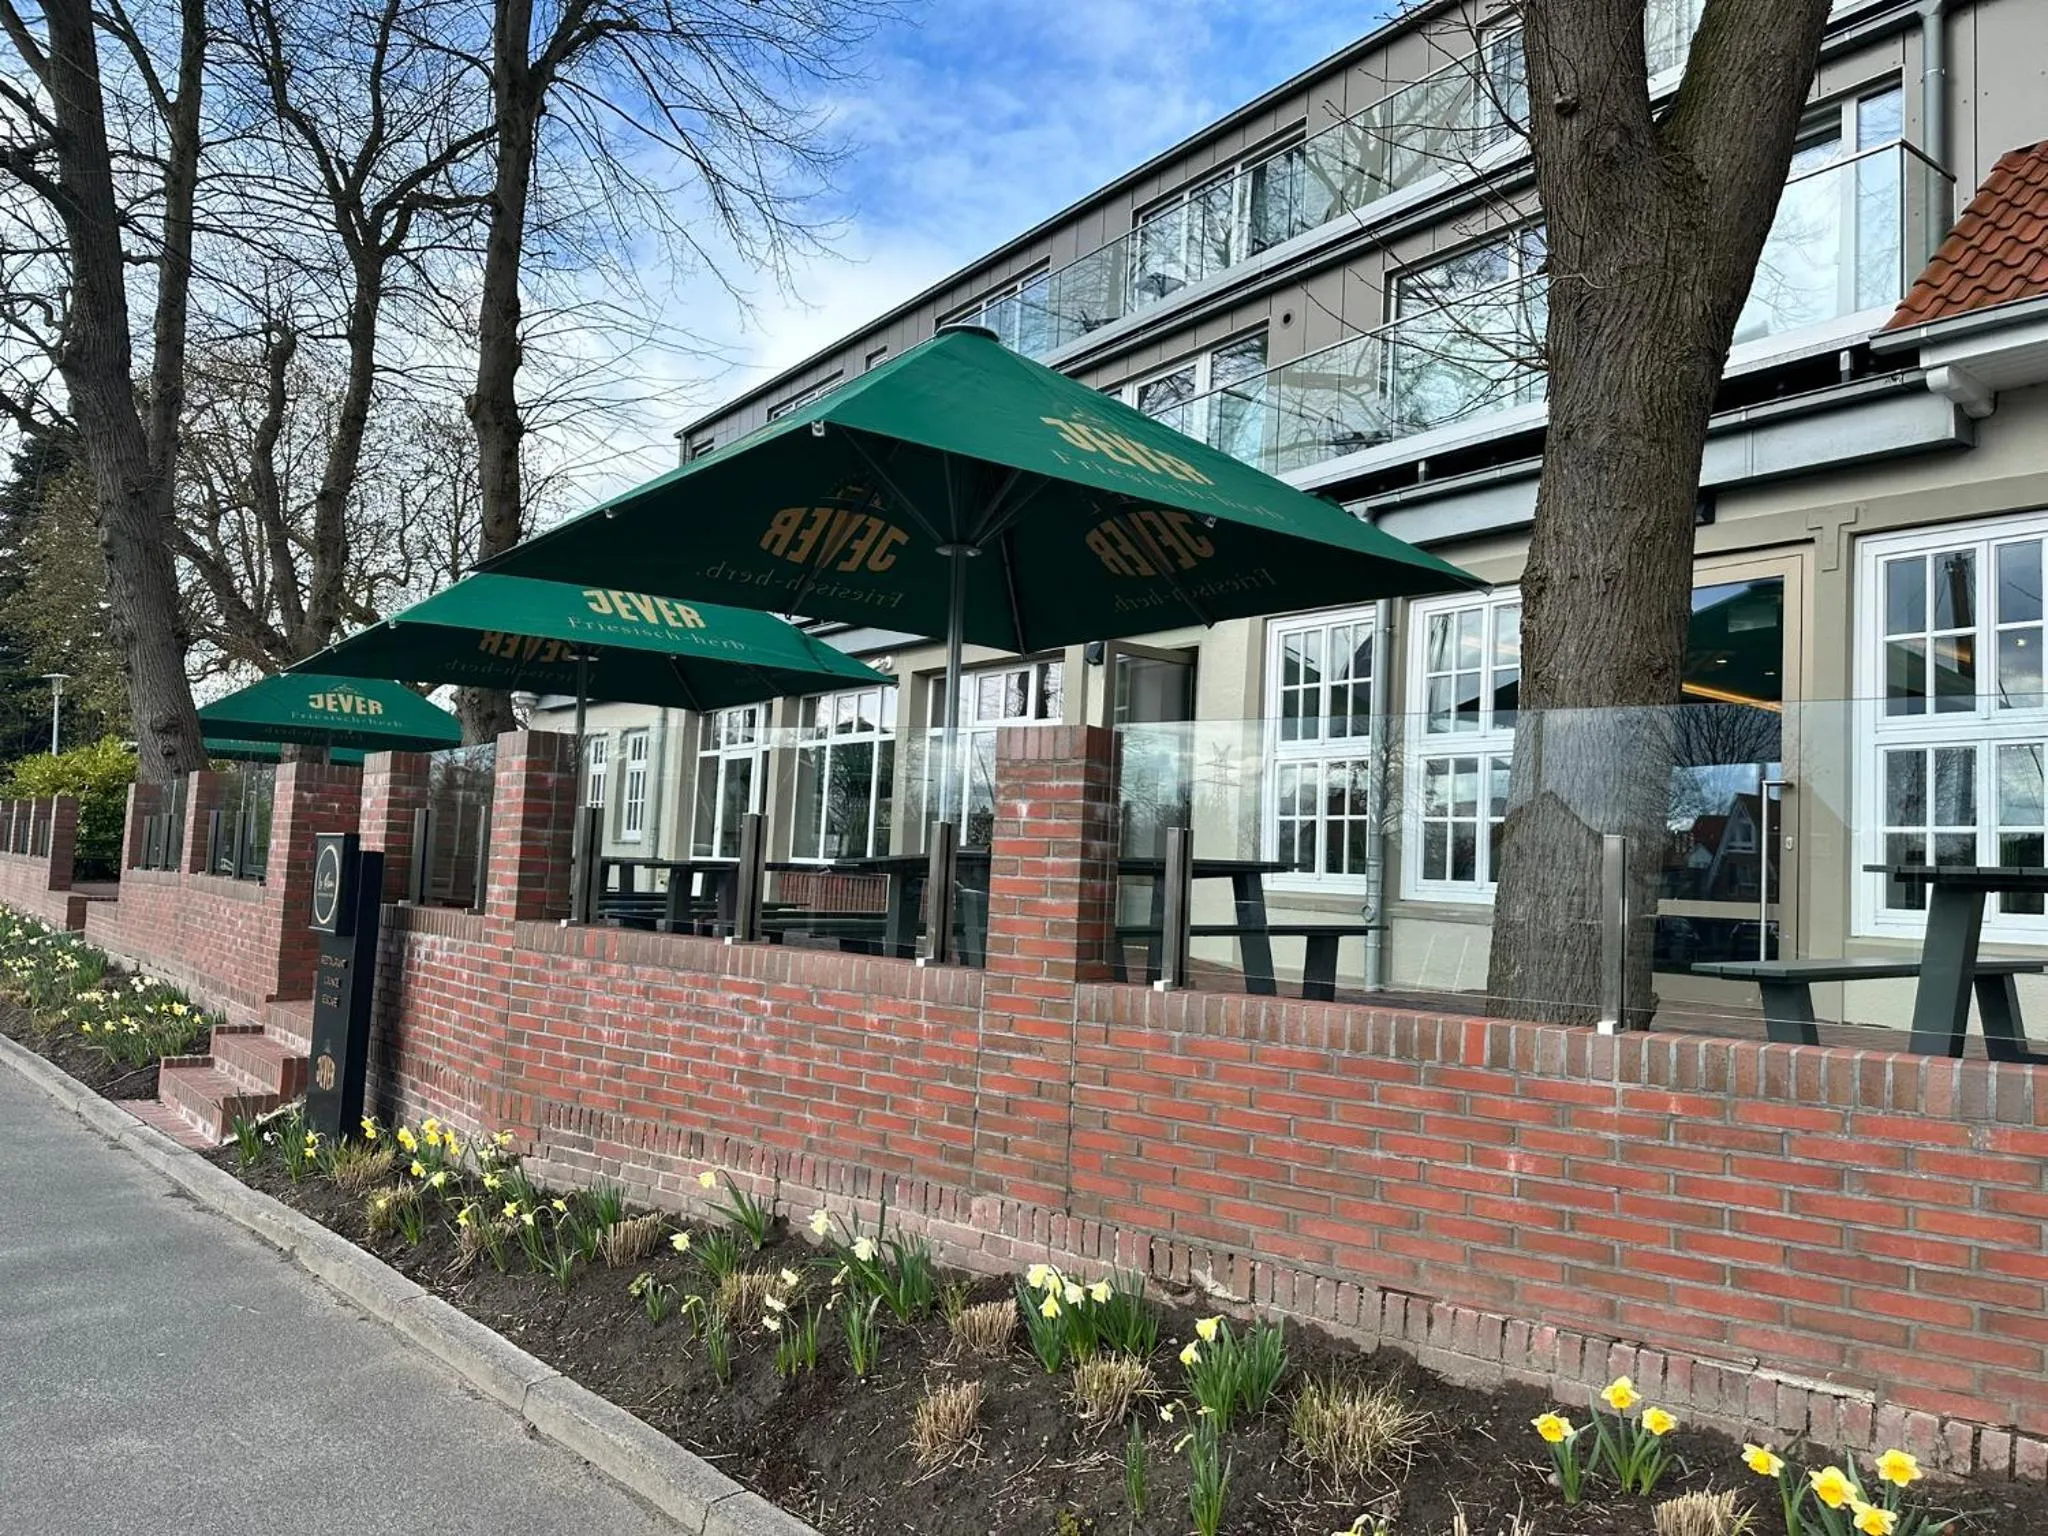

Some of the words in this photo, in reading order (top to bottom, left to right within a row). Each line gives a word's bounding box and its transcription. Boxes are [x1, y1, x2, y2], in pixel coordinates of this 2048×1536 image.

[1039, 416, 1215, 485] JEVER
[582, 589, 706, 629] JEVER
[308, 693, 383, 715] JEVER
